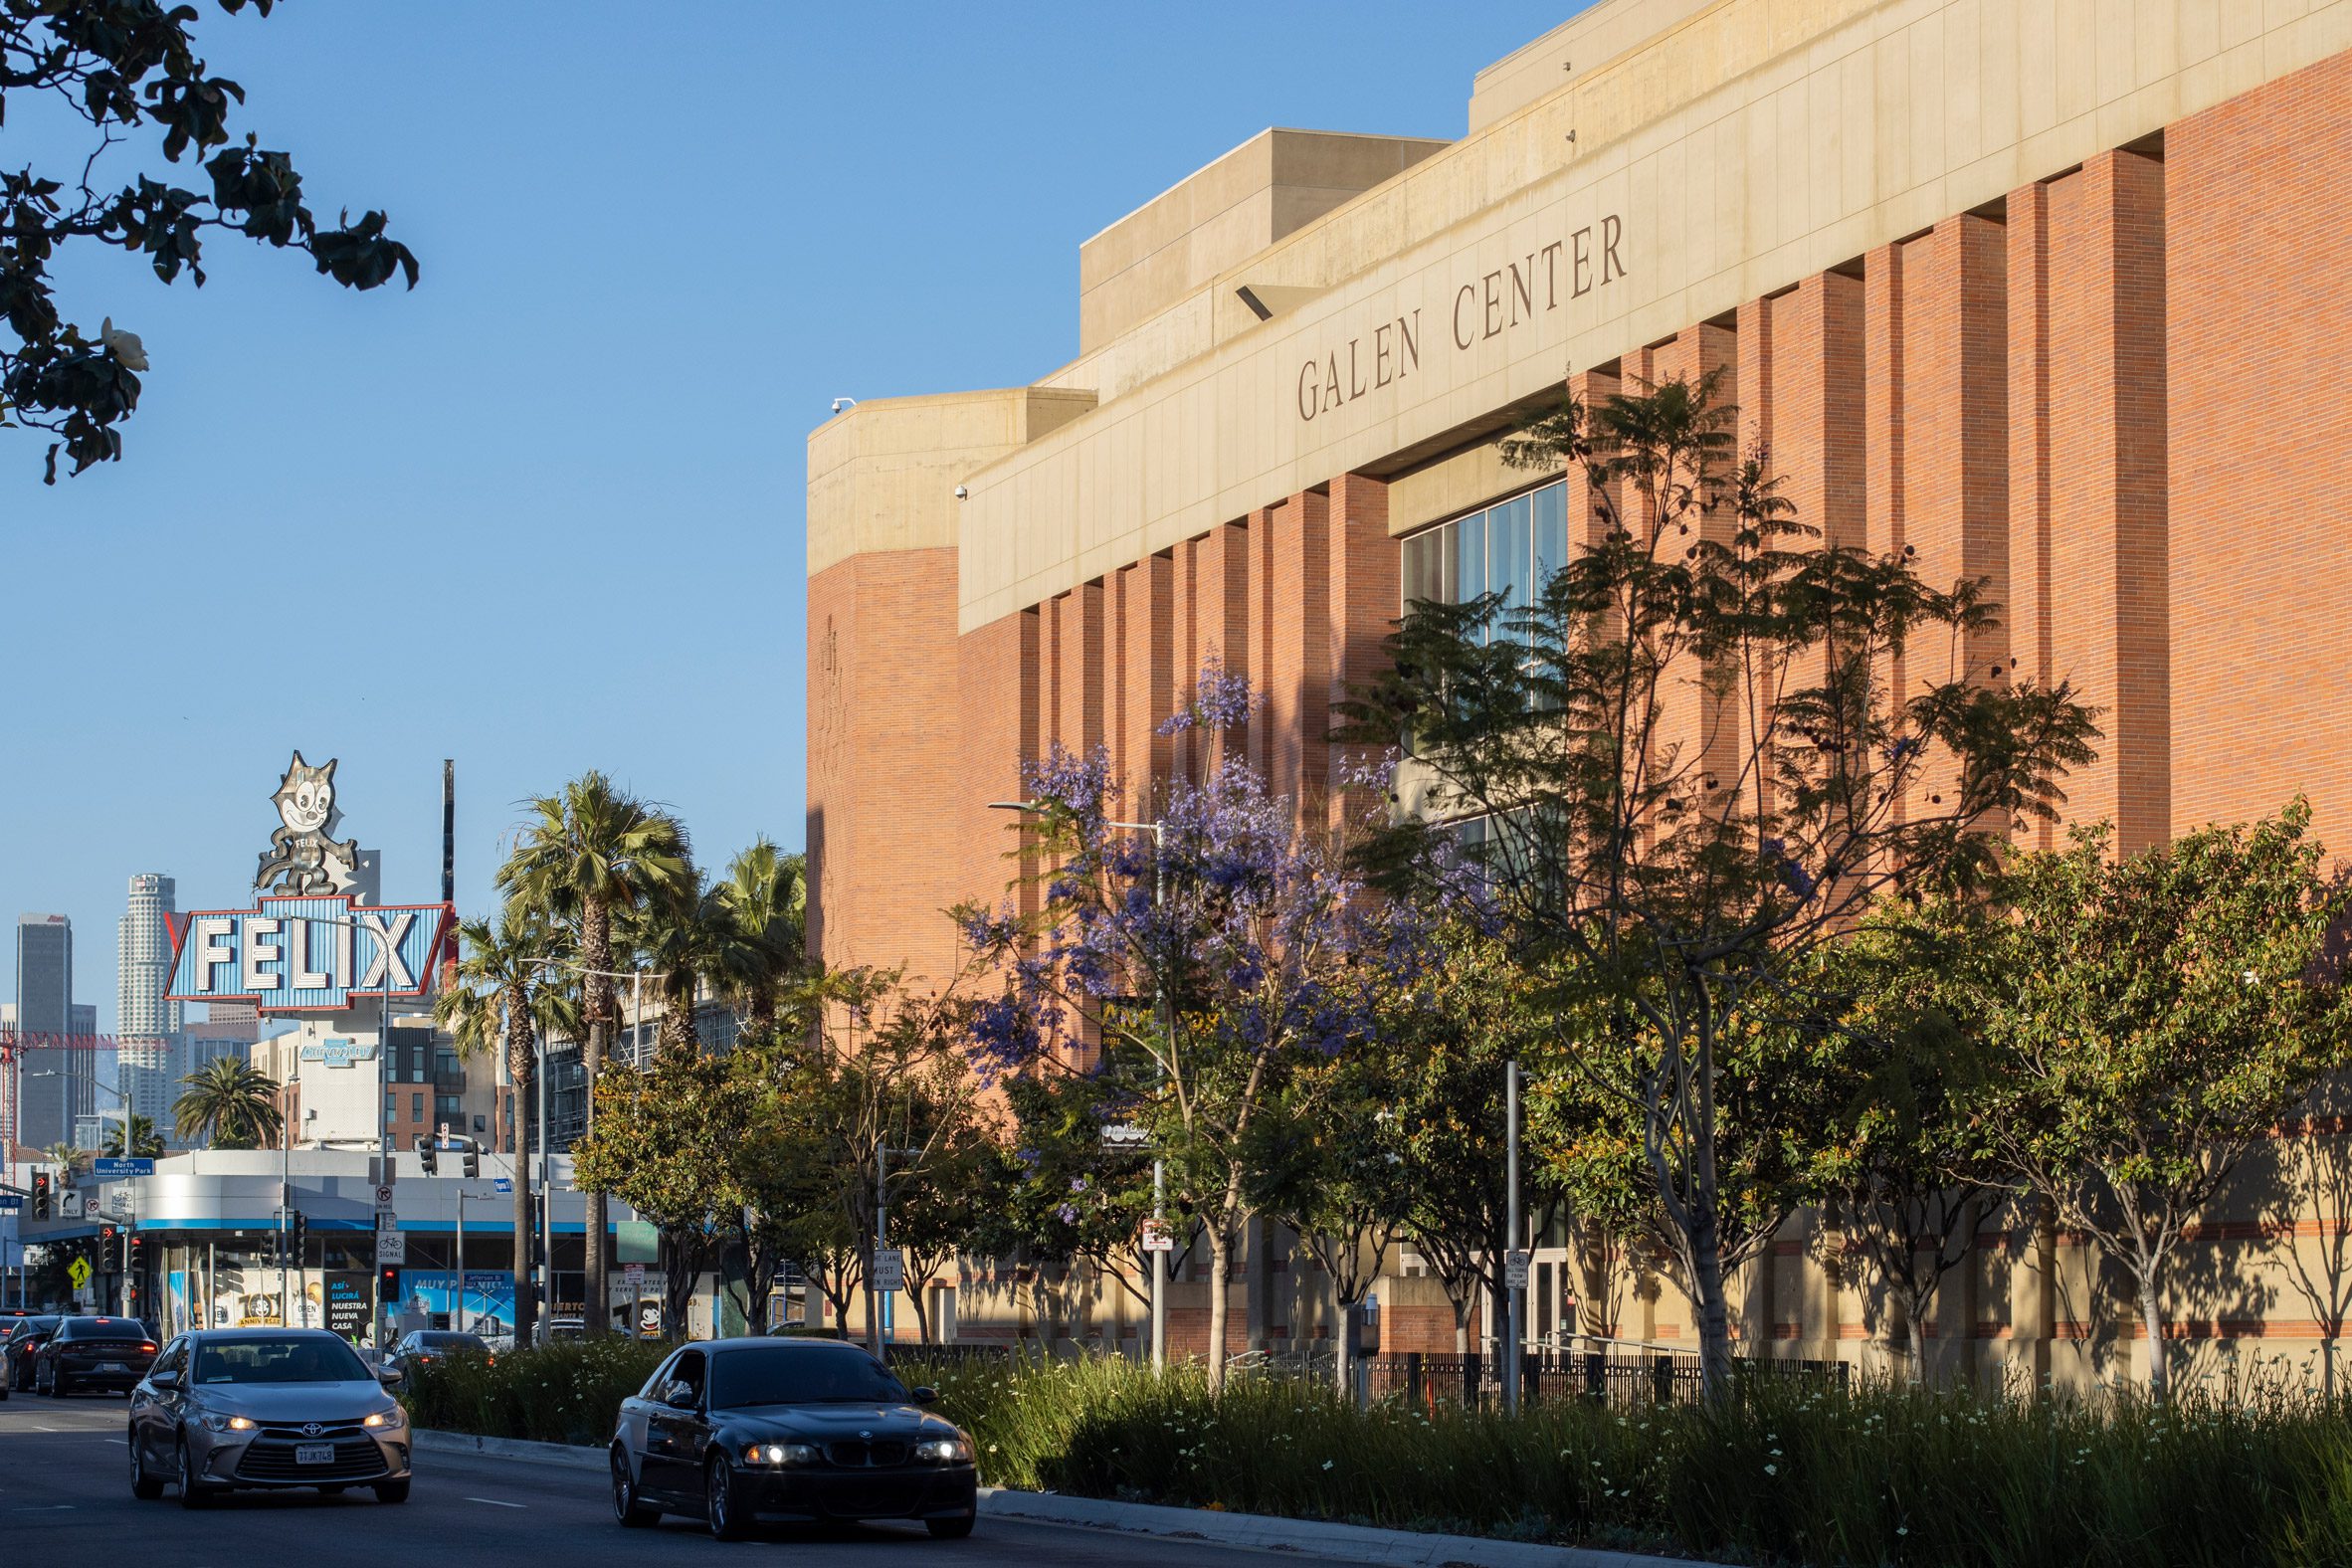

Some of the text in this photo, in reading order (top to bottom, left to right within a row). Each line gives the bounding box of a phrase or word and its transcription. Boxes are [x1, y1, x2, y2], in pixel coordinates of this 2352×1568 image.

[1298, 214, 1627, 421] GALEN CENTER
[295, 838, 318, 849] FELIX
[196, 914, 415, 991] FELIX
[416, 1279, 446, 1289] MUY
[331, 1291, 359, 1300] LUCIRÁ
[297, 1304, 316, 1313] OPEN
